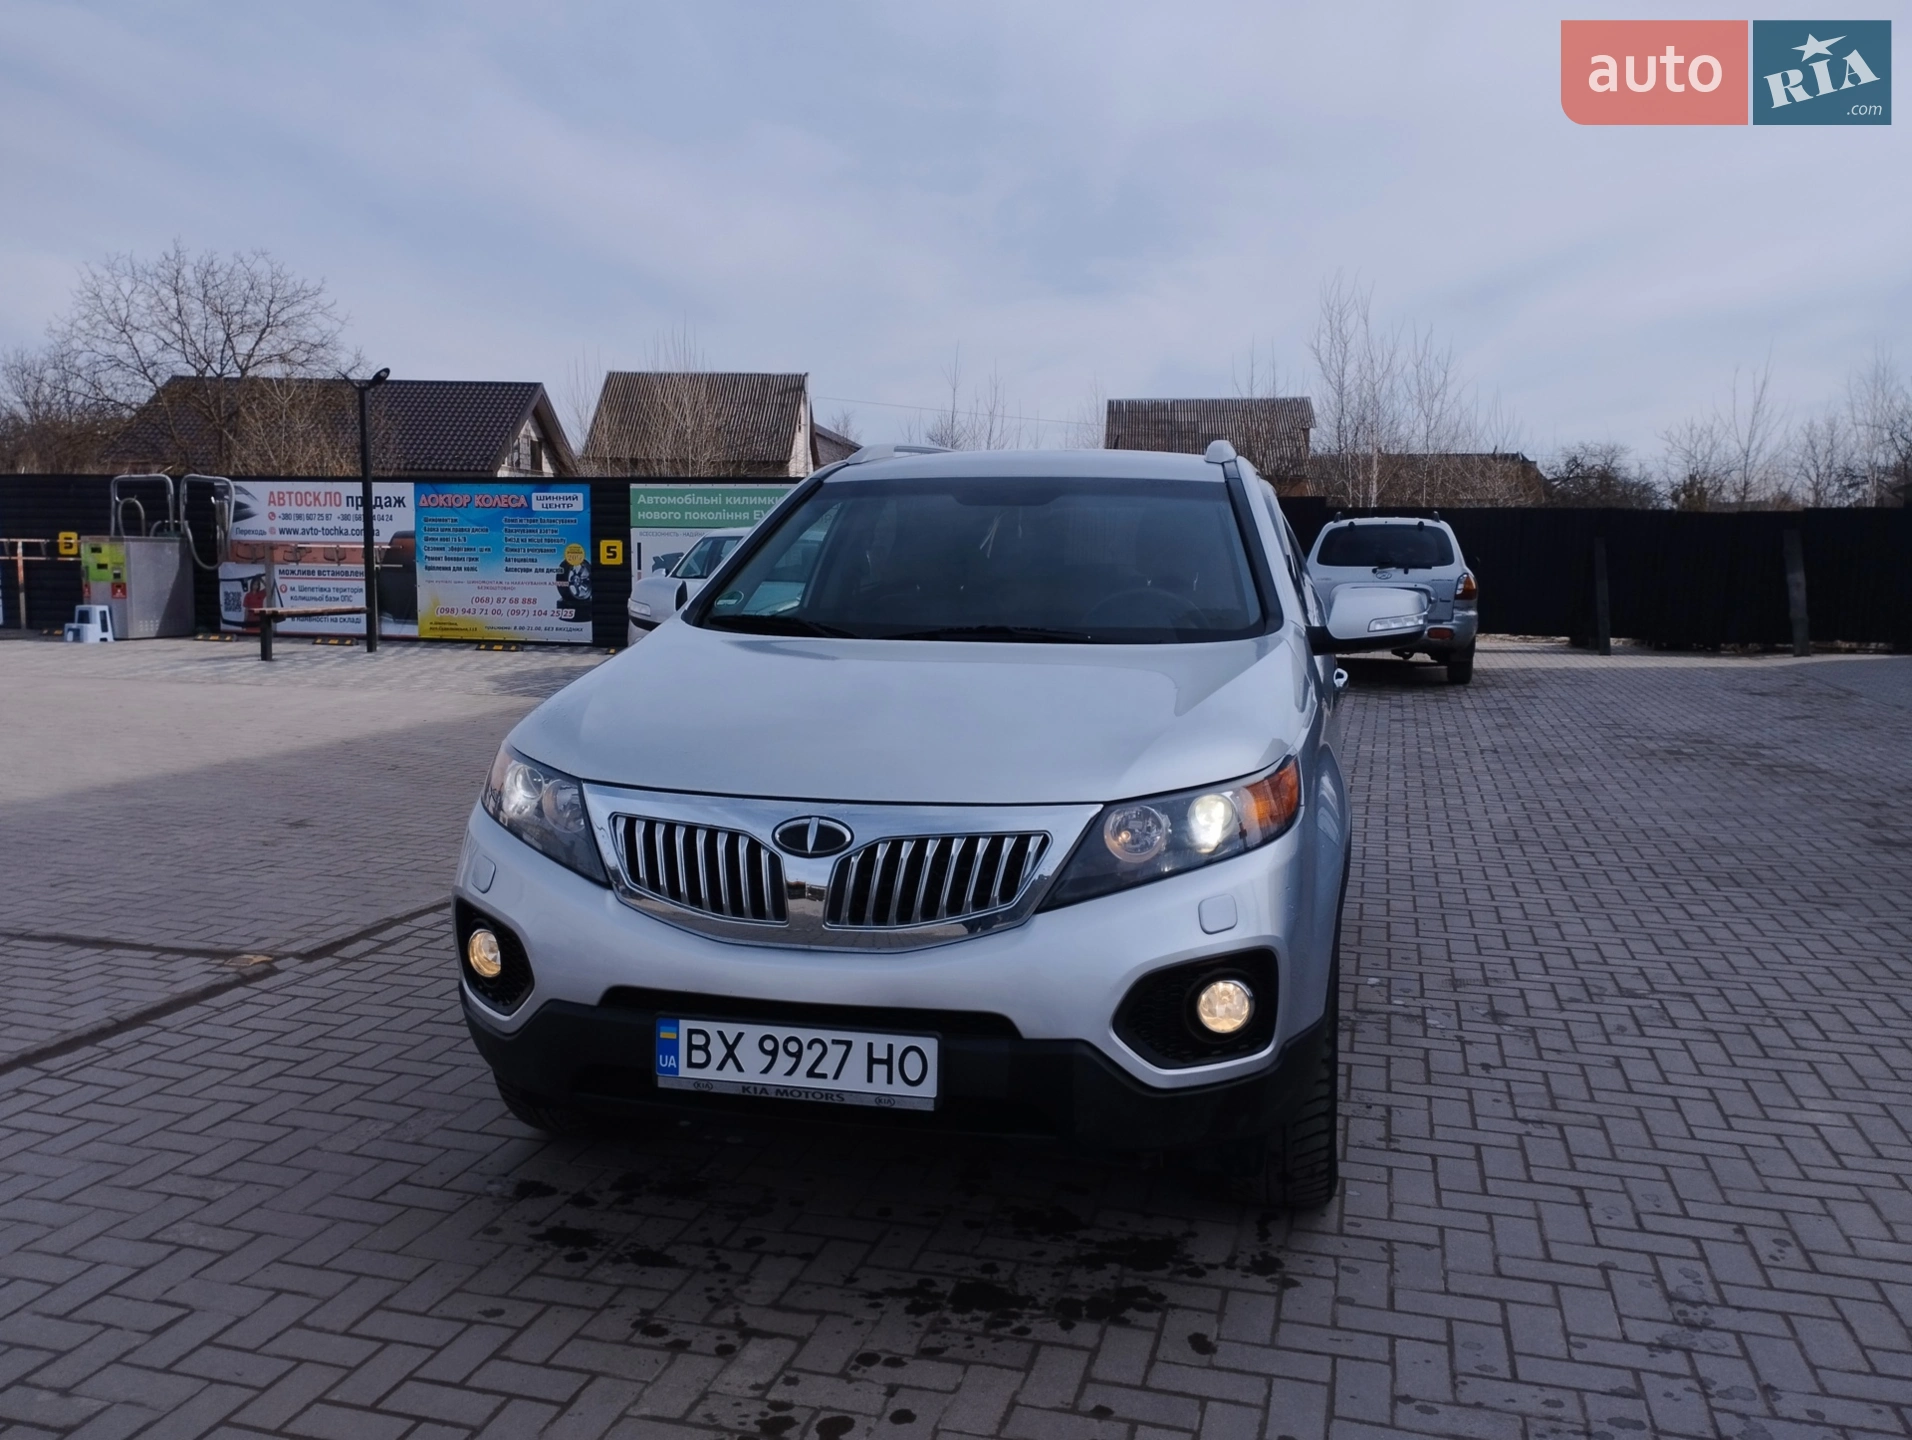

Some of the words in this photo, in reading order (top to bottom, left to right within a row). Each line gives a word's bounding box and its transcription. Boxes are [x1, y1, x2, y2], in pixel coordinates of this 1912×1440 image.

[268, 491, 342, 507] АВТОСКЛО
[346, 495, 406, 510] прдаж
[419, 493, 472, 508] ДОКТОР
[474, 494, 529, 508] КОЛЕСА
[536, 494, 579, 502] ШИННИЙ
[637, 493, 722, 505] Автомобільні
[278, 513, 292, 521] +380
[637, 511, 681, 520] нового
[684, 509, 750, 520] покоління
[235, 527, 267, 536] Переходь
[279, 526, 380, 536] www.avto-tochka.coa
[606, 545, 617, 559] 5
[279, 569, 316, 577] можливе
[317, 569, 365, 578] встановлен
[298, 585, 331, 593] Шепетівка
[332, 585, 364, 594] територія
[290, 594, 324, 602] колишньої
[325, 594, 340, 602] бази
[471, 596, 494, 605] (068)
[509, 597, 519, 605] 68
[521, 597, 538, 605] 888
[436, 606, 459, 616] (098)
[461, 607, 477, 615] 943
[506, 608, 530, 618] (097)
[532, 609, 548, 617] 104
[339, 616, 362, 624] складі
[659, 1054, 677, 1069] UA
[686, 1028, 745, 1073] BX
[758, 1034, 853, 1081] 9927
[866, 1042, 929, 1087] HO
[695, 1082, 712, 1090] KIA
[741, 1085, 770, 1096] KIA
[775, 1088, 846, 1102] MOTORS
[877, 1097, 894, 1105] KIA
